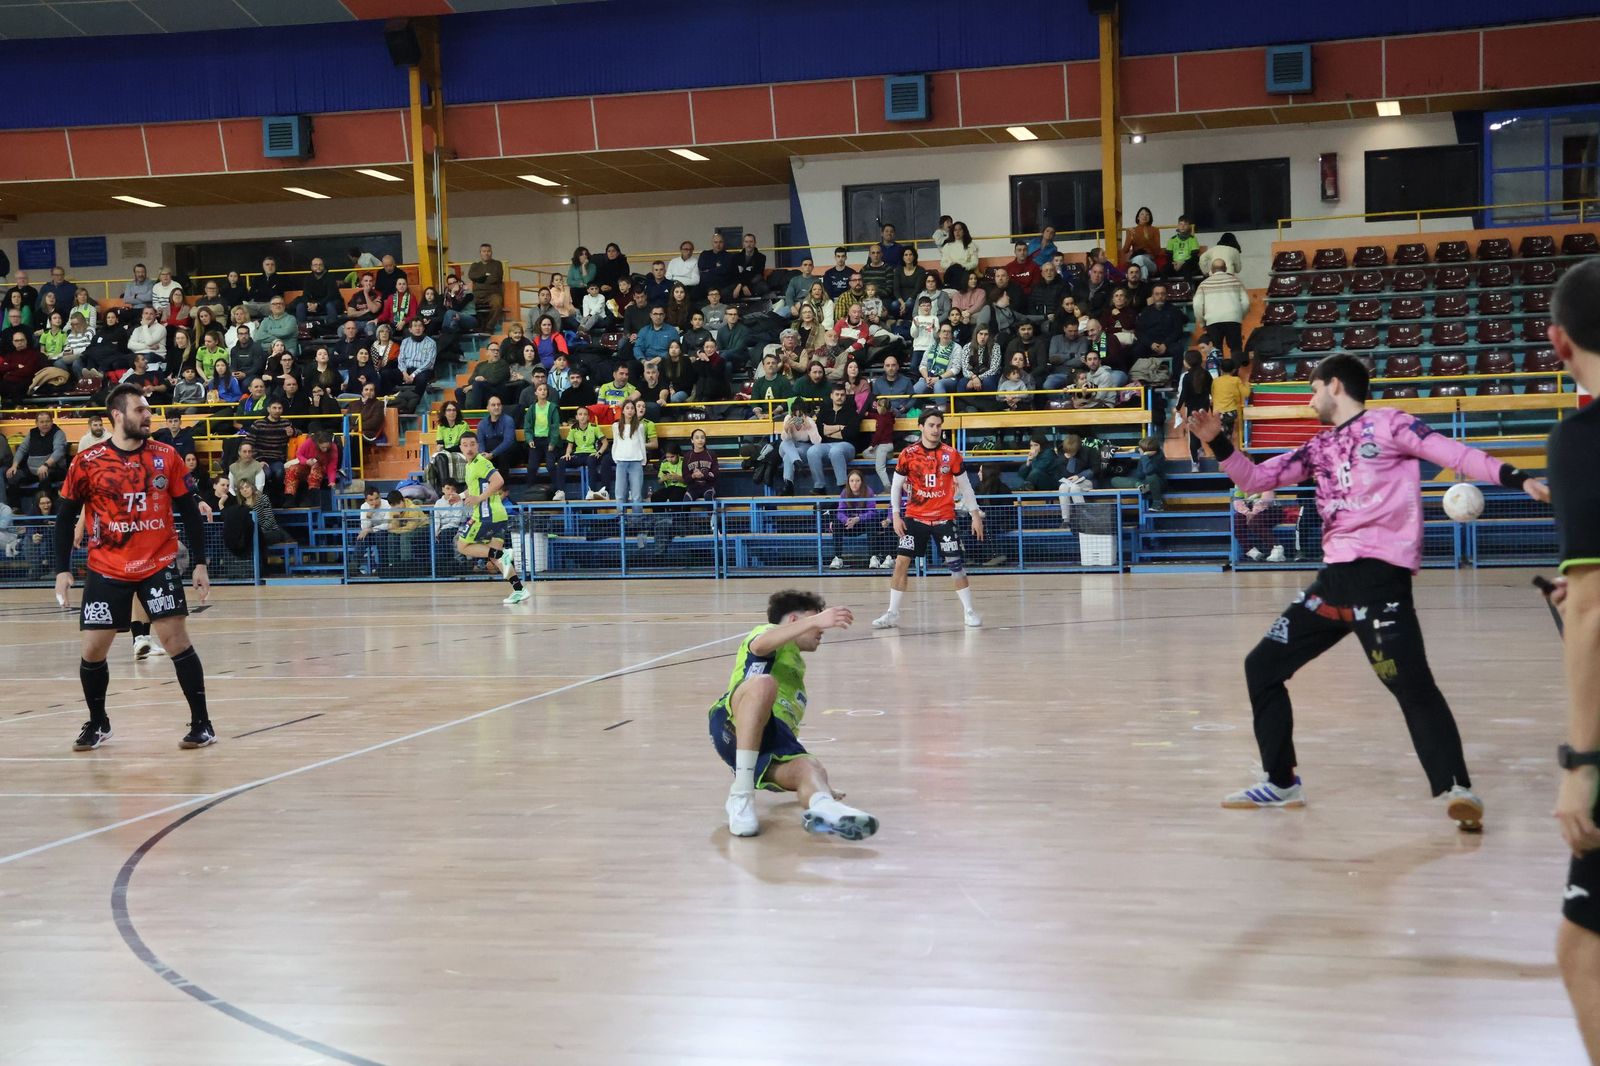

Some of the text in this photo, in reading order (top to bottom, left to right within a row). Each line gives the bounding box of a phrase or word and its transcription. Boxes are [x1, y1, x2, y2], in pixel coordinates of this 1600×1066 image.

[765, 387, 774, 400] A
[925, 473, 936, 488] 19
[123, 492, 147, 513] 73
[109, 518, 165, 533] ABANCA
[85, 601, 109, 612] MOR
[84, 608, 113, 621] VEGA
